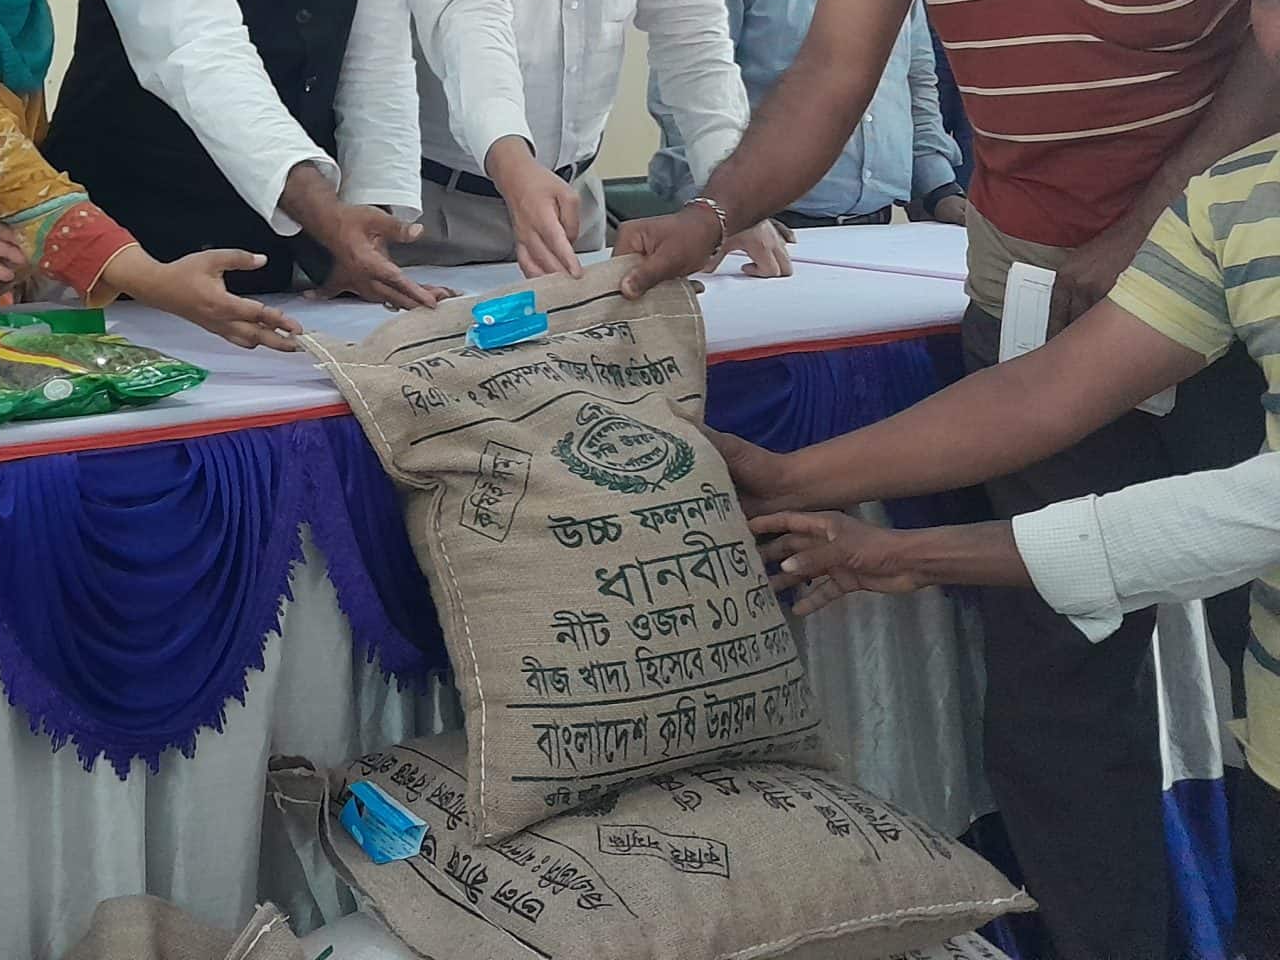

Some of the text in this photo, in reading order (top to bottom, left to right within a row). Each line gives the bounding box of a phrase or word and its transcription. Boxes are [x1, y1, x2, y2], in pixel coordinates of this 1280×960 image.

[548, 514, 622, 548] উচ্চ
[595, 530, 751, 605] ধানবীজ
[551, 610, 611, 651] নীট
[625, 604, 698, 640] ওজন
[706, 596, 739, 630] ১০
[521, 656, 572, 696] বীজ
[579, 659, 630, 694] খাদ্য
[635, 645, 705, 690] হিসেবে
[532, 712, 650, 771] বাংলাদেশ
[657, 695, 697, 748] কৃষি
